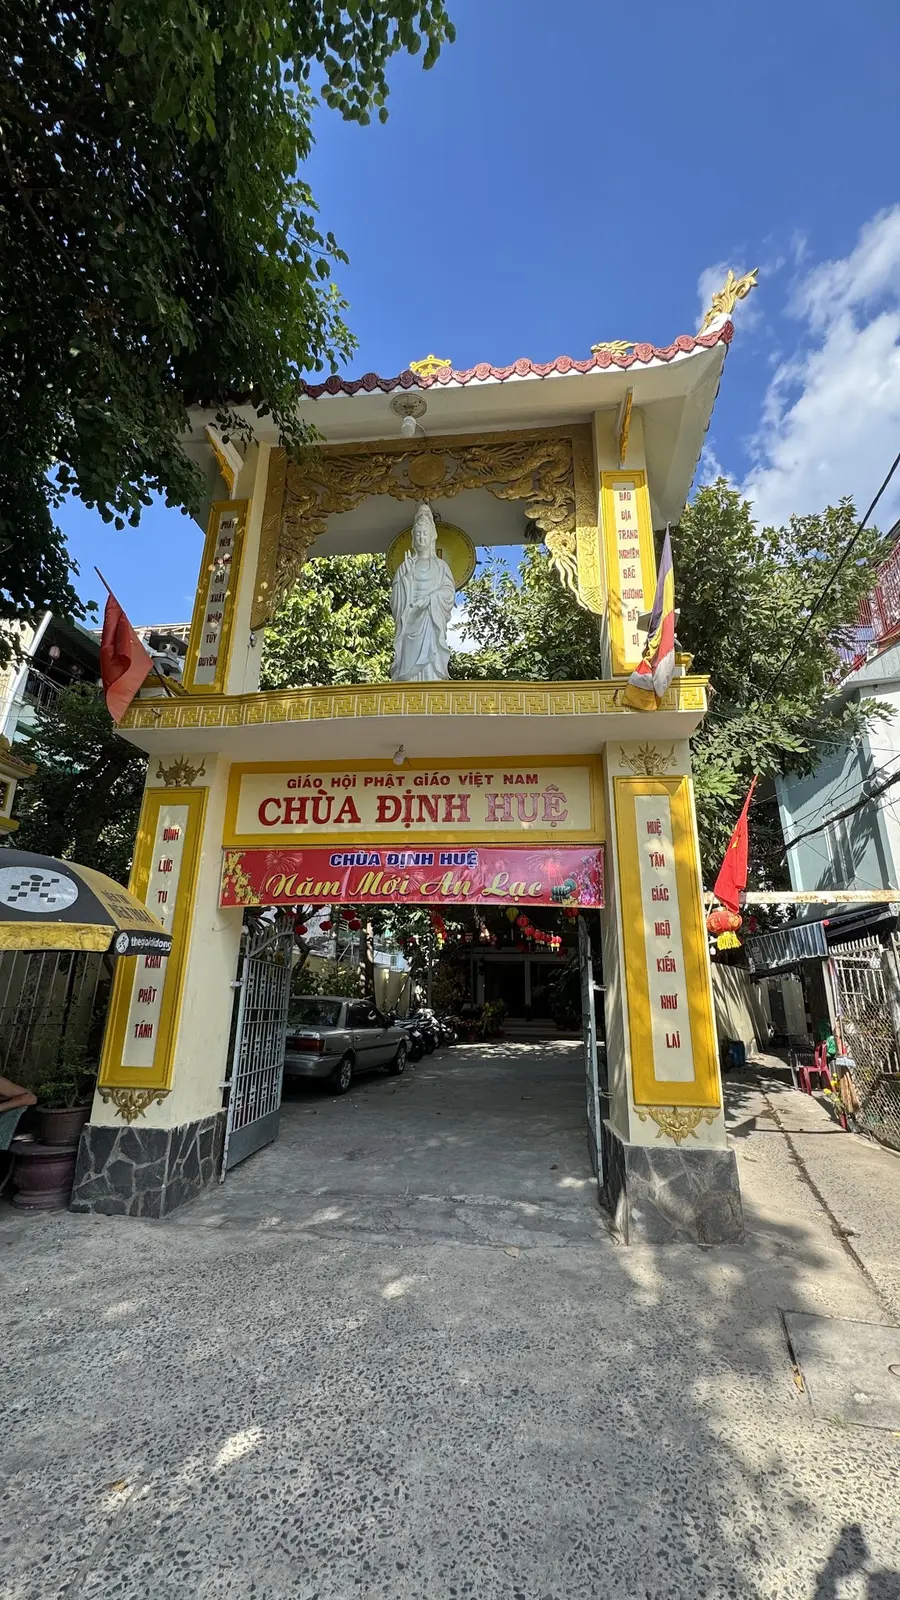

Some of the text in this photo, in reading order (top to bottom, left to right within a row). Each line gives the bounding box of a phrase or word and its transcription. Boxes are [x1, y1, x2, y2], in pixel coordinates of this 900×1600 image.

[617, 529, 639, 540] TRANG
[622, 565, 636, 579] SẮC
[287, 774, 324, 789] GIÁO
[364, 774, 406, 789] PHẬT
[413, 772, 451, 787] GIÁO
[503, 774, 539, 785] NAM
[258, 784, 569, 829] CHÙA ĐỊNH HUỆ
[163, 827, 180, 843] ĐỊNH
[646, 818, 662, 836] HUỆ
[330, 849, 479, 869] CHÙA ĐỊNH HUỆ
[265, 871, 544, 902] Năm Mới An Lạc
[651, 884, 669, 901] GIÁC
[158, 890, 168, 904] TU
[654, 919, 671, 939] NGỘ
[656, 950, 677, 972] KIẾN
[138, 986, 158, 1005] PHẬT
[660, 993, 678, 1010] NHƯ
[134, 1020, 154, 1038] TÁNH
[666, 1031, 681, 1049] LAI
